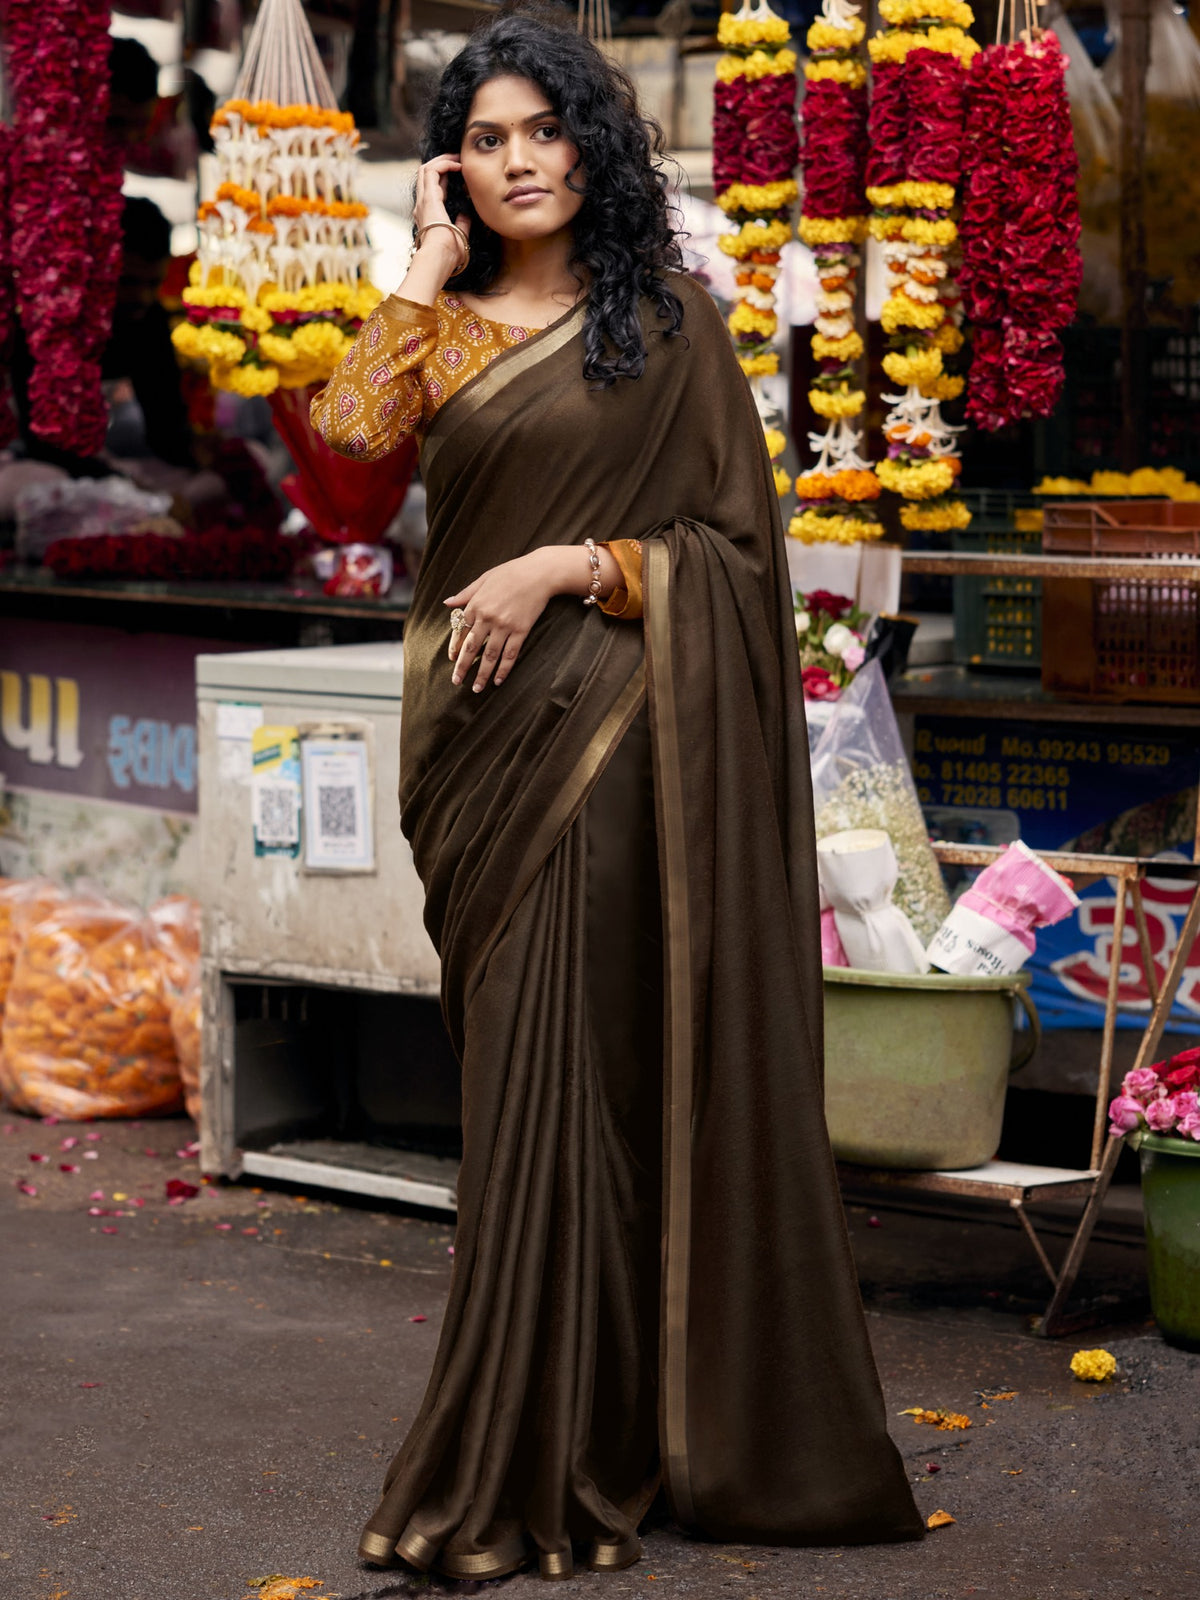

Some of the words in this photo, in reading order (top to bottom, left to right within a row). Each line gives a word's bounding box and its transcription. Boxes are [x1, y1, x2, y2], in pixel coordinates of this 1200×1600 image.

[1107, 743, 1170, 766] 95529
[941, 760, 1001, 783] 81405
[1007, 763, 1070, 787] 22365
[942, 783, 1001, 807] 72028
[1007, 787, 1068, 811] 60611
